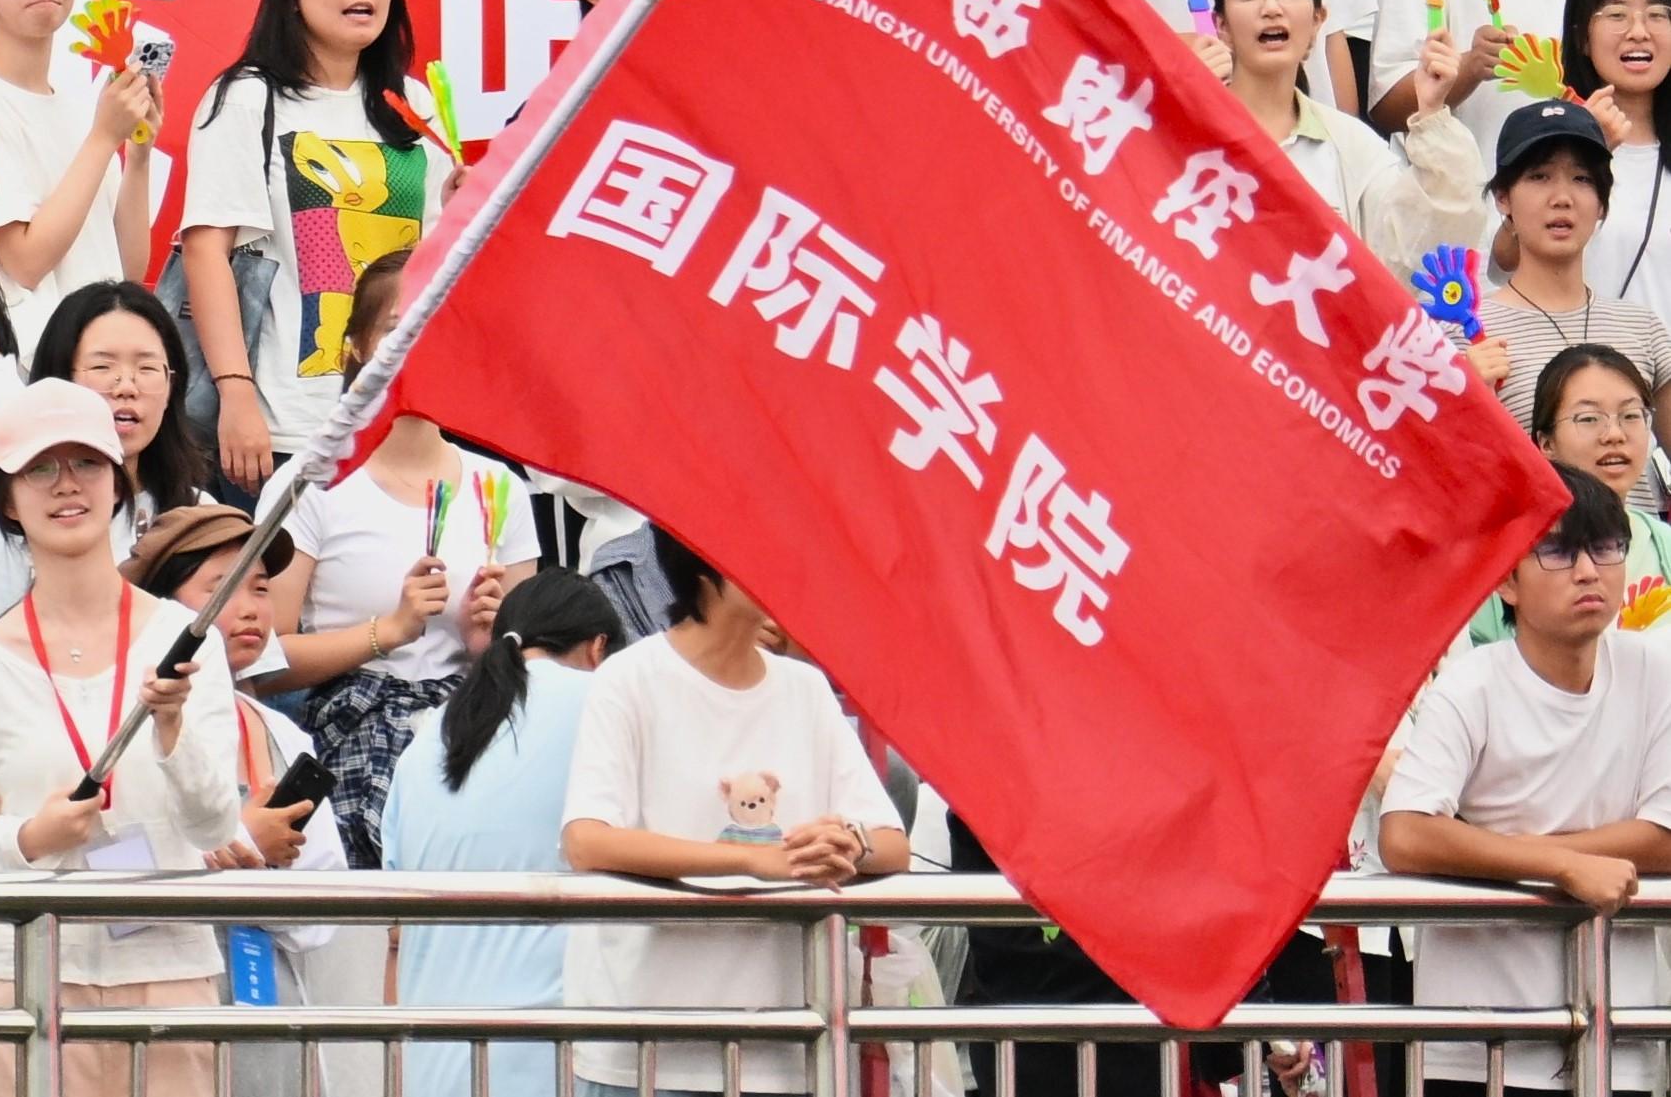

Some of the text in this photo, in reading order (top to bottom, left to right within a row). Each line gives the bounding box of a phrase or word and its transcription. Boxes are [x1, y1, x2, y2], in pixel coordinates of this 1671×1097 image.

[546, 119, 1131, 647] 国际学院
[925, 41, 1059, 179] UNIVERSITY
[1059, 178, 1091, 212] OF
[1088, 208, 1199, 312] FINANCE
[1194, 304, 1252, 358] AND
[1251, 348, 1402, 480] ECONOMICS
